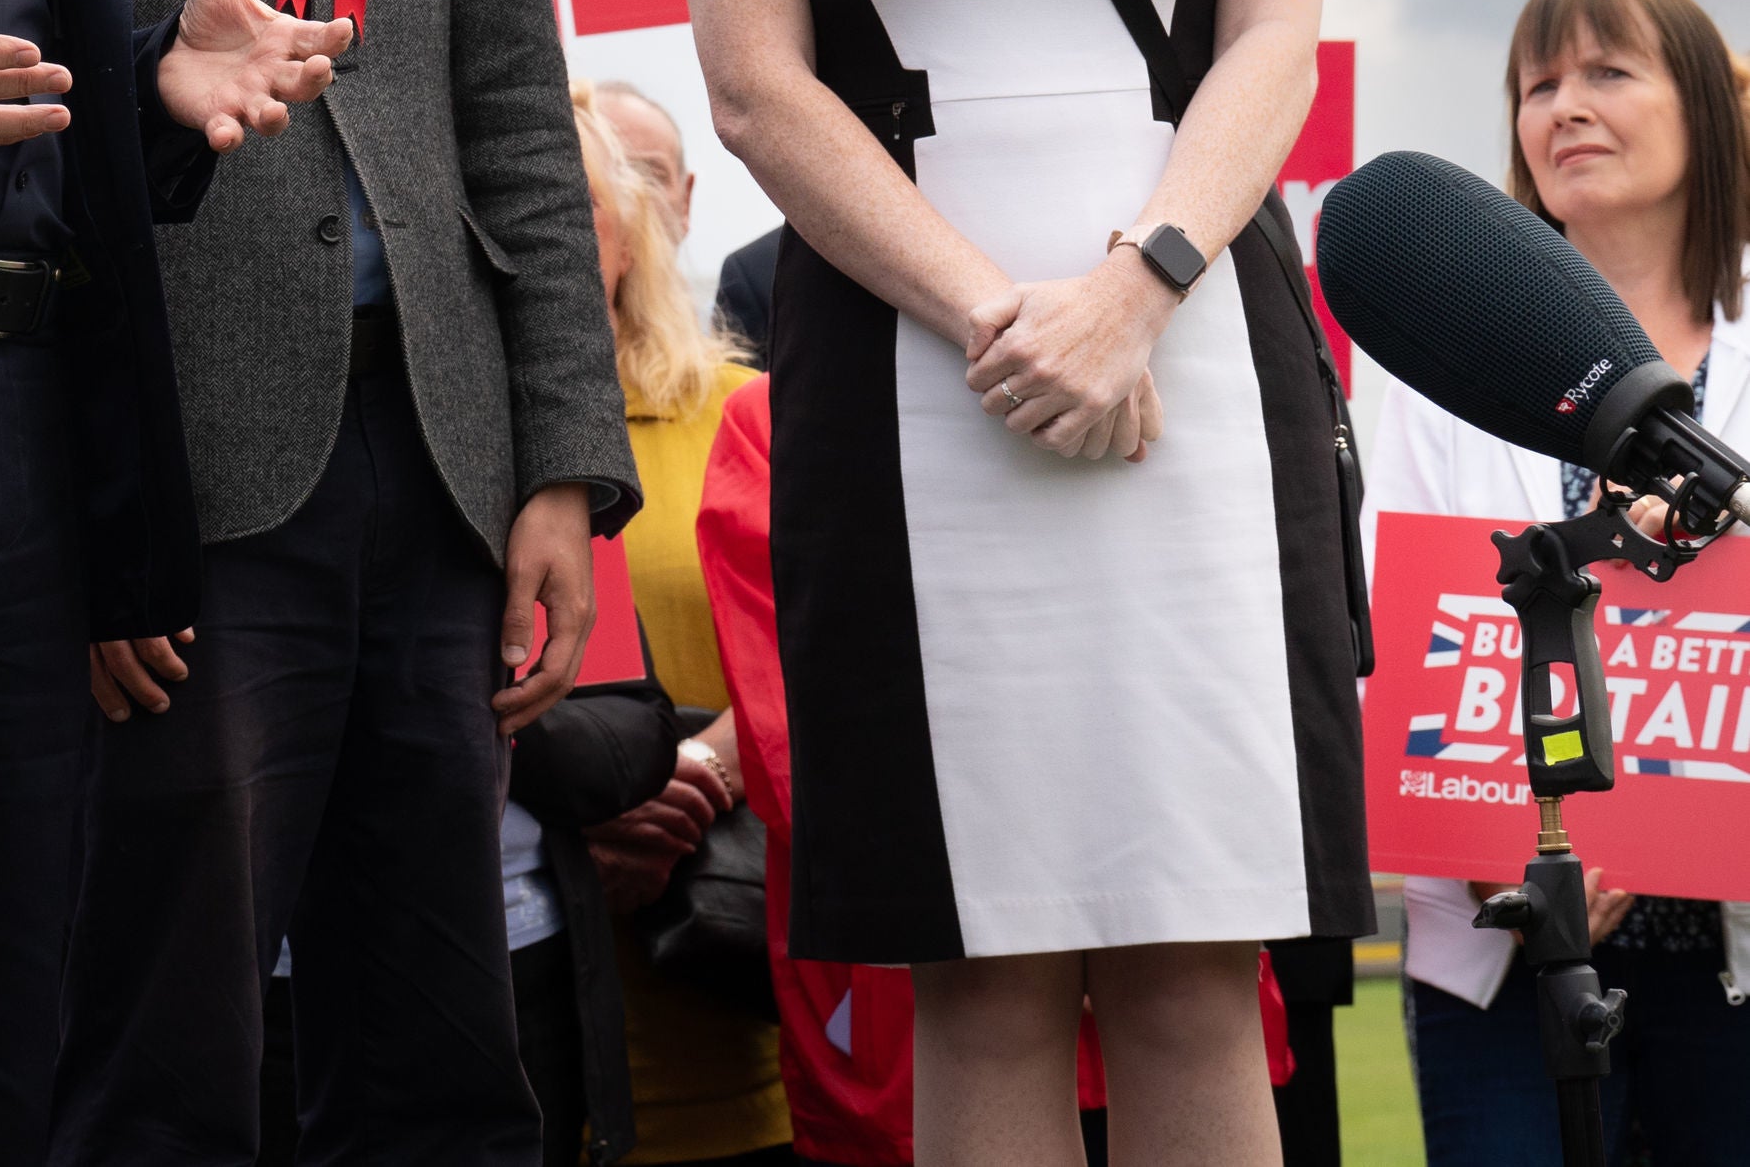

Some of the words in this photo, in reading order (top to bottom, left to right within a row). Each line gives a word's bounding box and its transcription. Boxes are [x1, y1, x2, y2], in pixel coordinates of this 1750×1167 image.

[1564, 358, 1612, 405] Rycote
[1607, 633, 1639, 668] A
[1454, 666, 1750, 753] BTAI
[1427, 772, 1531, 806] Labour
